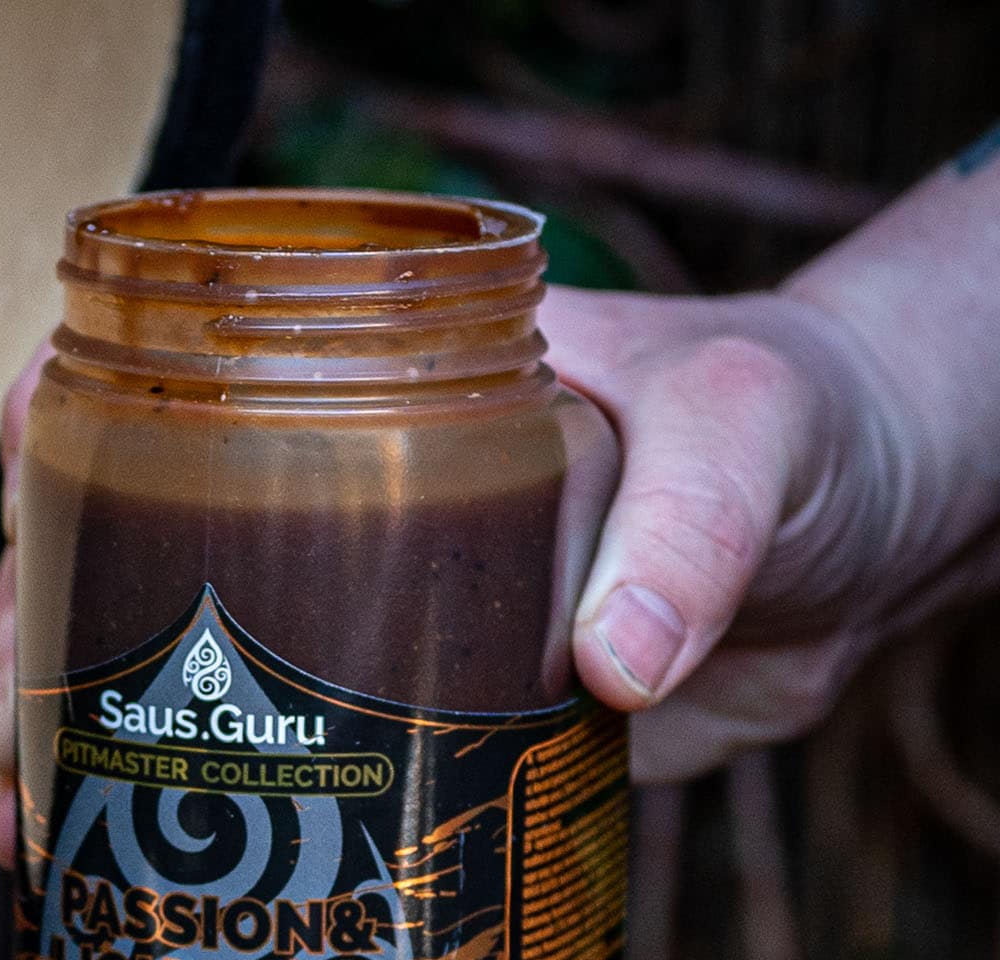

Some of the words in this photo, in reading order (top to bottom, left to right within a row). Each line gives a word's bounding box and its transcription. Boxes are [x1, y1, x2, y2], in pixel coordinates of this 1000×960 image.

[100, 689, 326, 747] Saus.Guru
[61, 737, 189, 781] PITMASTER
[201, 761, 384, 788] COLLECTION
